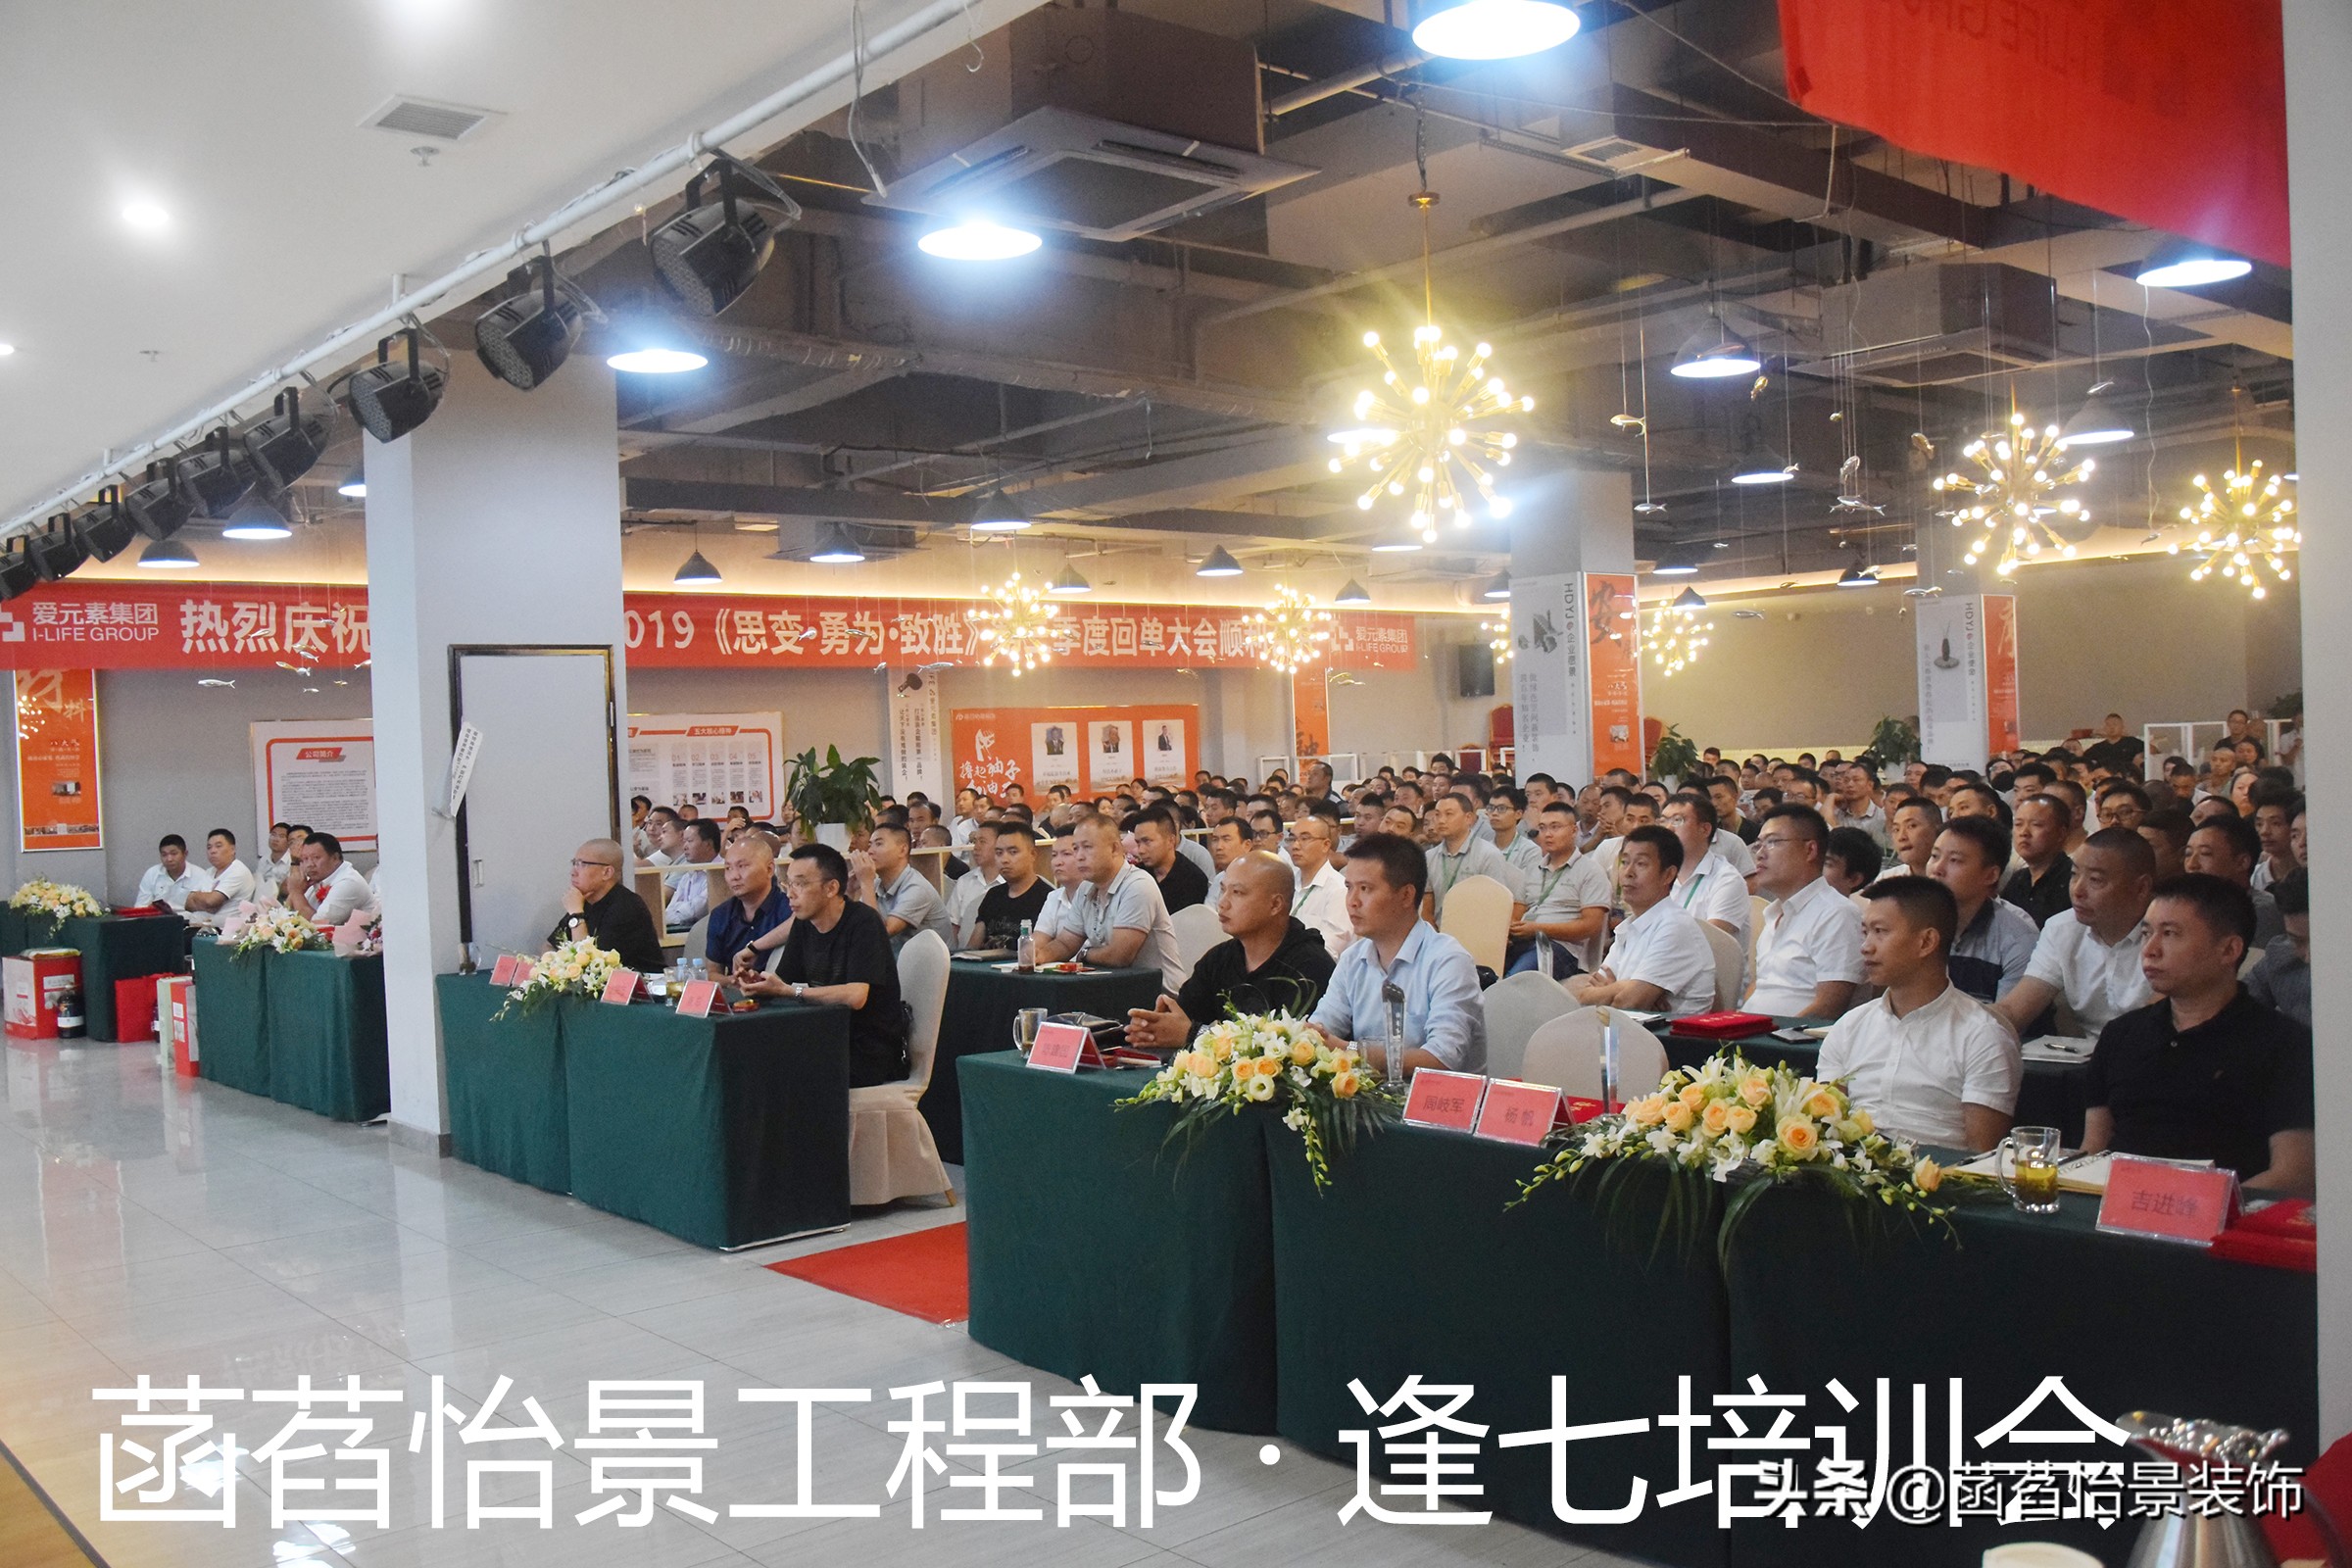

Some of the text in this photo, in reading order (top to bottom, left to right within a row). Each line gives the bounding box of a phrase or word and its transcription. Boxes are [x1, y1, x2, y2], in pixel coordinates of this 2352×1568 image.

[32, 602, 158, 625] 爱元素集团
[32, 627, 159, 642] I-LIFE GROUP
[180, 599, 369, 654] 热烈庆祝
[1355, 626, 1408, 644] 爱元素集团
